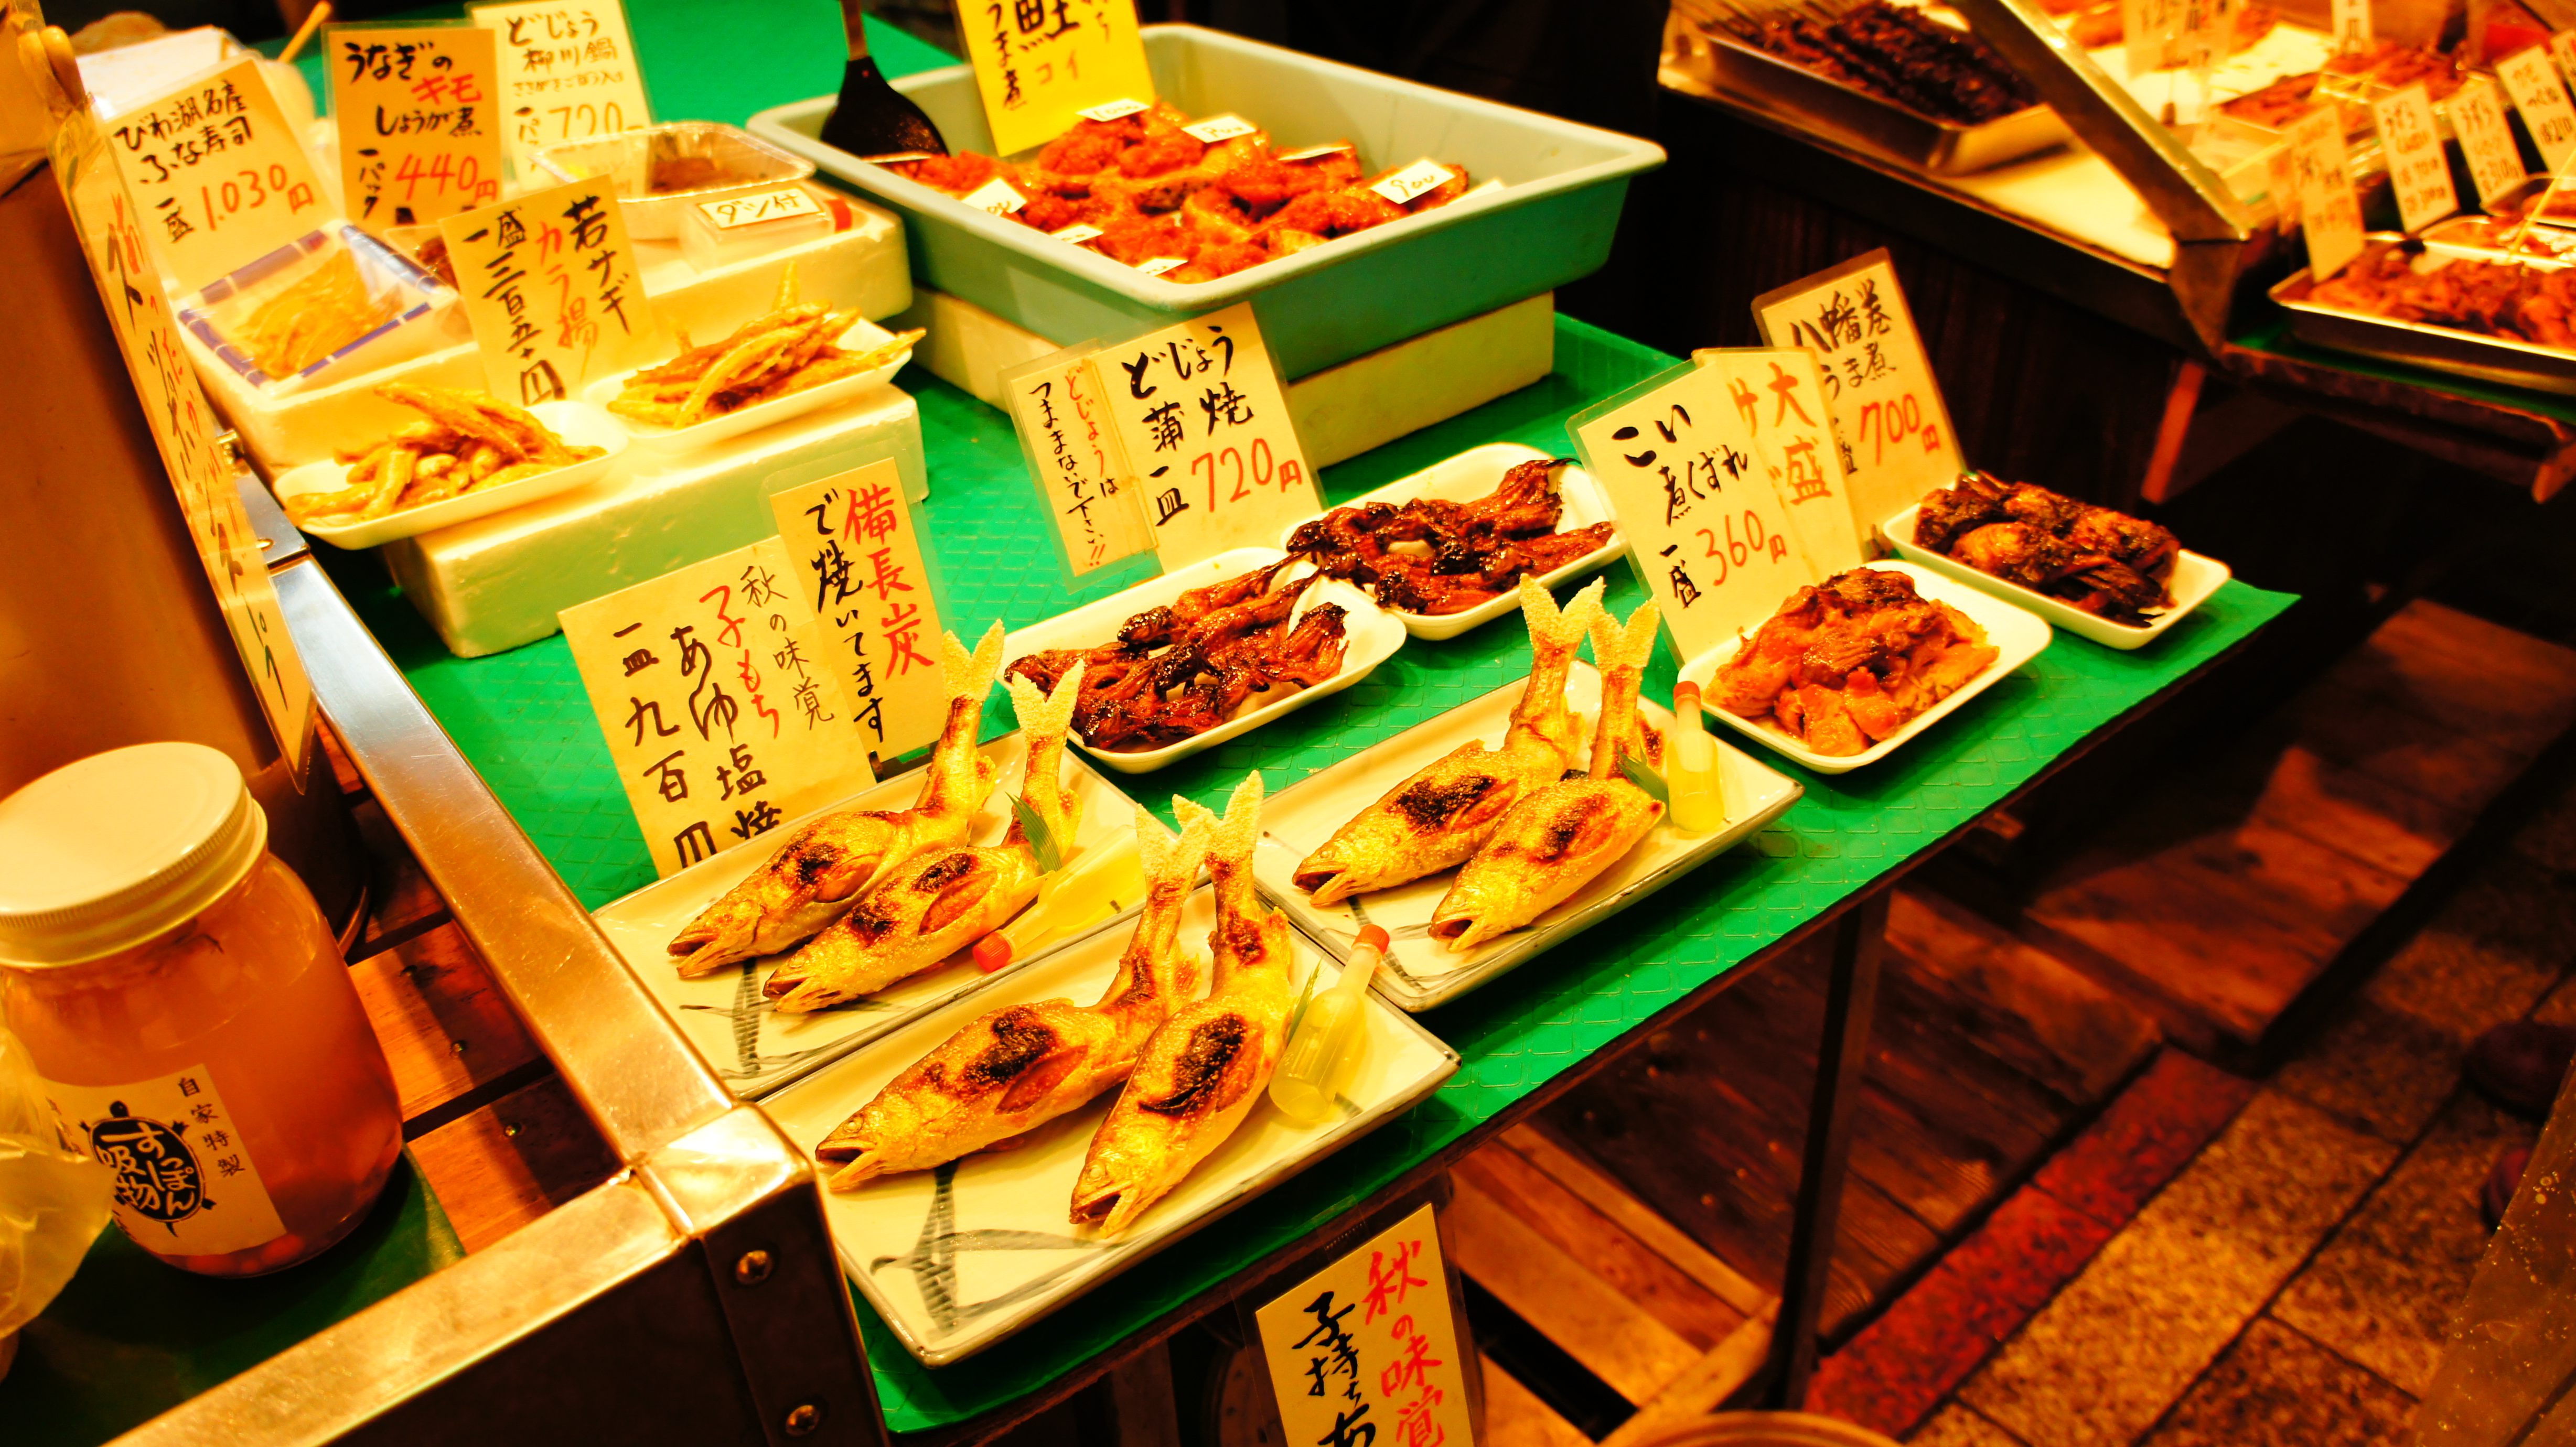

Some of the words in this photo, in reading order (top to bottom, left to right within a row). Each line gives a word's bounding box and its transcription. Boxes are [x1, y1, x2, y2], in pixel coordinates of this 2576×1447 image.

[344, 41, 454, 85] うなぎの
[505, 10, 600, 47] どじょう
[112, 78, 249, 152] びわ湖名産
[375, 104, 484, 138] しょうが煮
[411, 73, 483, 106] キモ
[138, 115, 253, 184] ふな寿司
[394, 153, 498, 206] 440円
[562, 195, 632, 336] 若サギ
[1121, 325, 1235, 399] どじょう
[1820, 341, 1897, 402] うま煮
[1065, 366, 1120, 499] どじょうは
[1142, 381, 1255, 453] 蒲焼
[1611, 404, 1692, 468] こい
[1767, 361, 1832, 506] 大盛
[1859, 393, 1940, 467] 700円
[1149, 465, 1190, 527] 一皿
[1190, 437, 1303, 513] 720円
[843, 482, 935, 681] 備長炭
[1695, 510, 1787, 587] 360円
[739, 565, 835, 731] 秋の味覚
[803, 488, 884, 743] で焼いてます
[699, 584, 781, 741] 子もち
[178, 1077, 245, 1178] 自家特製
[1361, 1240, 1445, 1447] 秋の味覚
